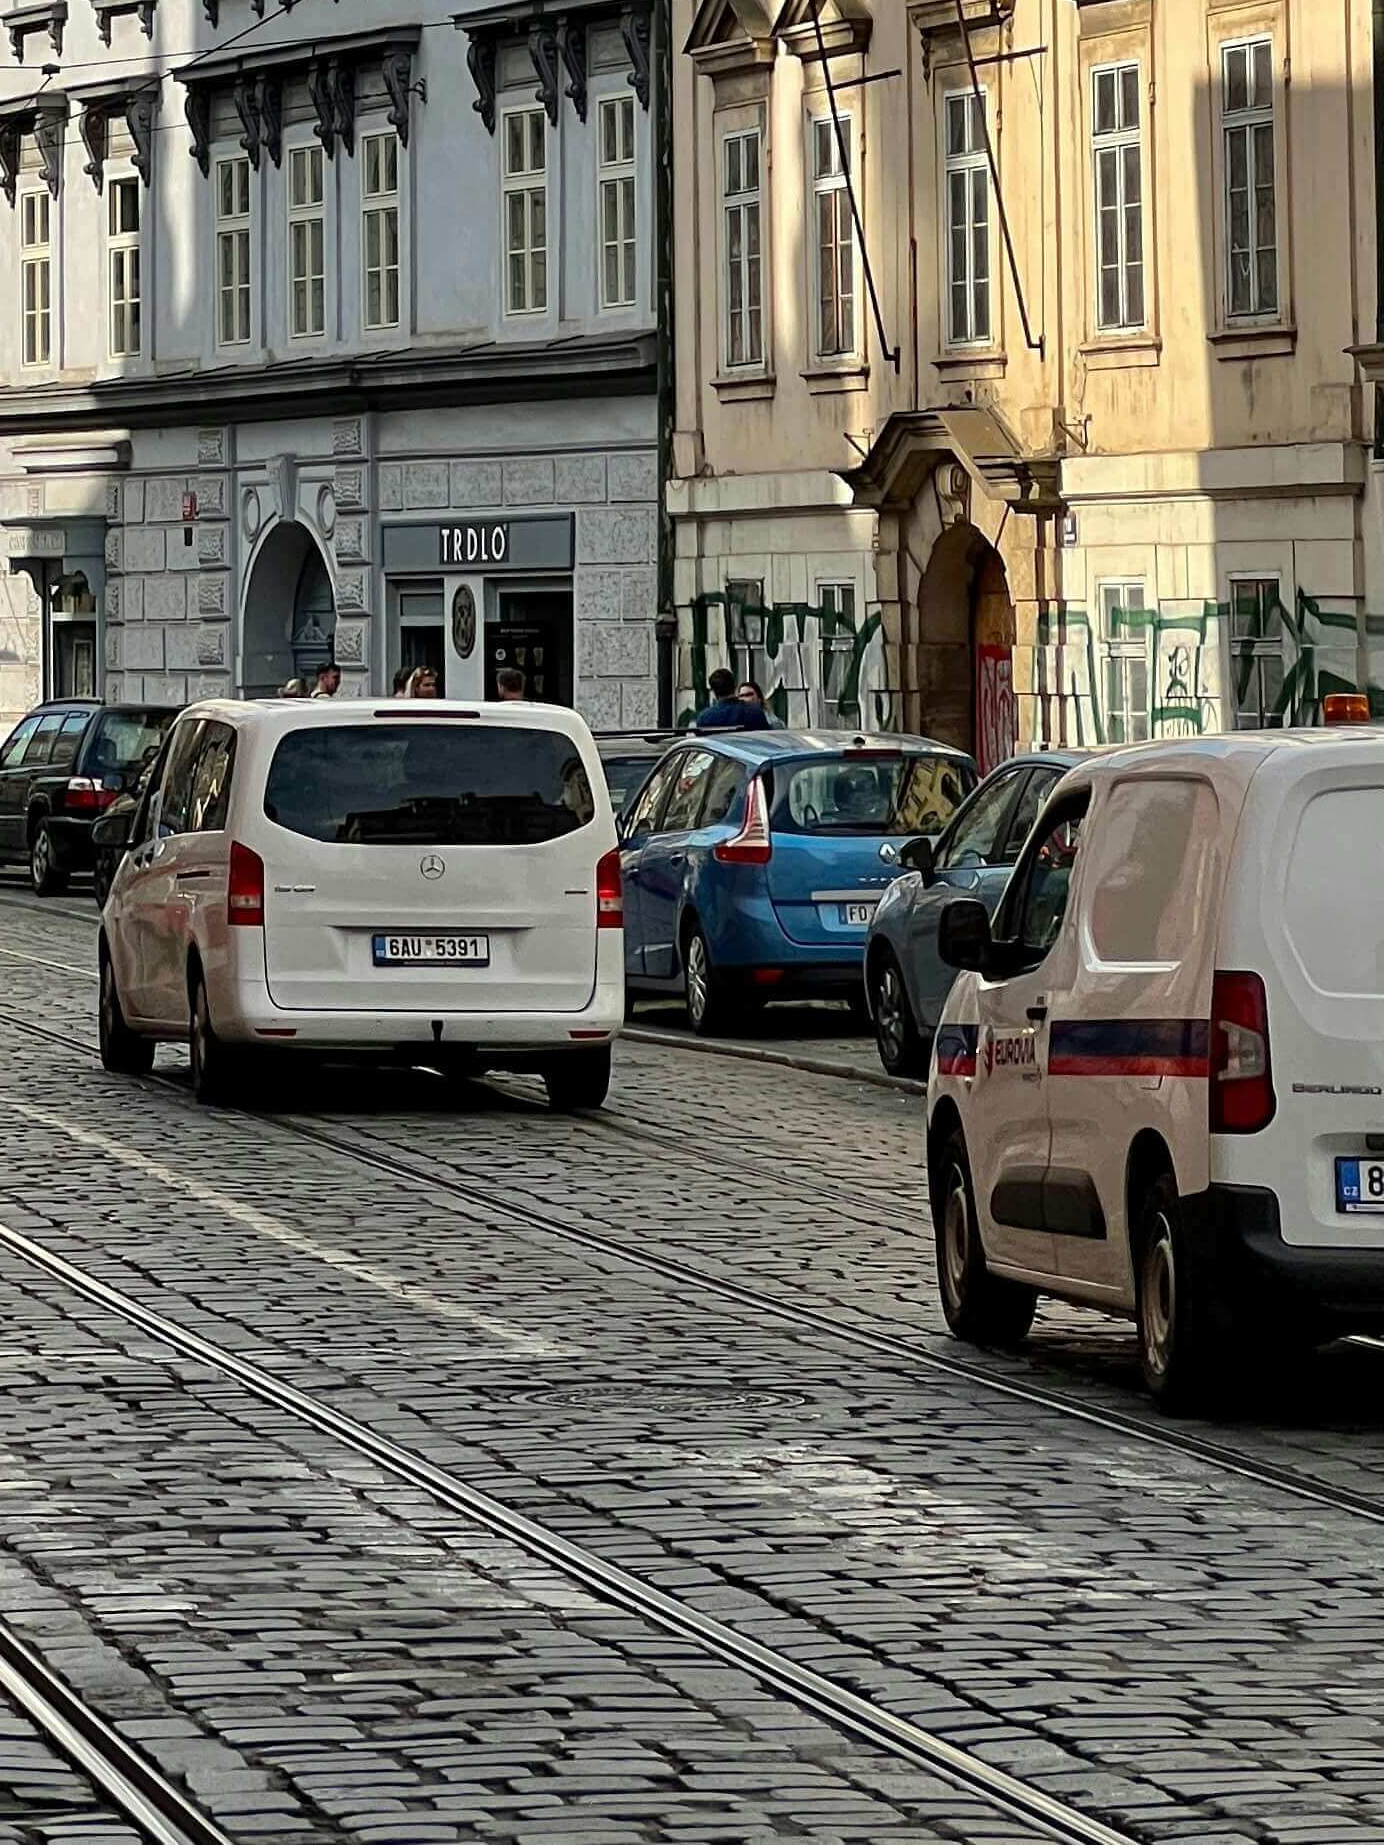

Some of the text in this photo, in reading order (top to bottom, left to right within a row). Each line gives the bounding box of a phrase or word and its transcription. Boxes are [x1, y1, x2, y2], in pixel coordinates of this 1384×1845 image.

[390, 938, 478, 957] 6AU 5391
[1343, 1186, 1358, 1196] CZ
